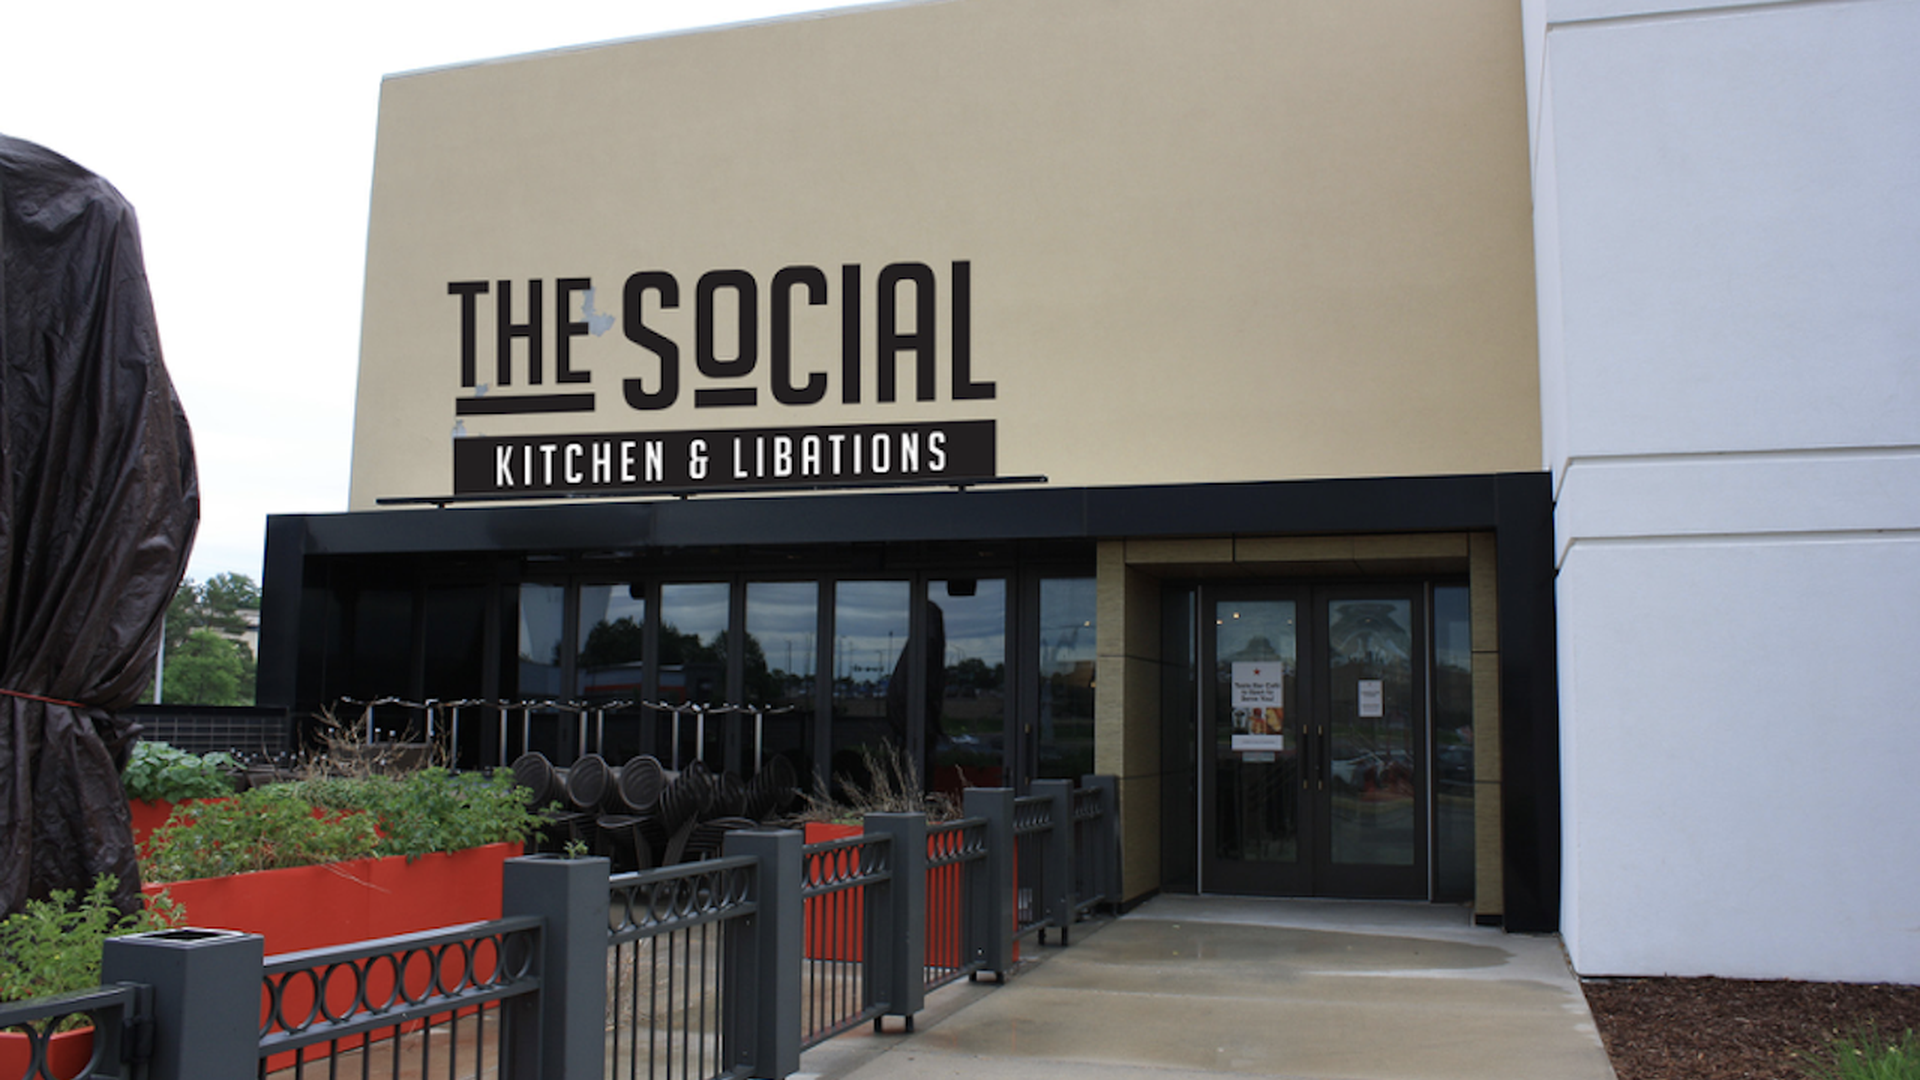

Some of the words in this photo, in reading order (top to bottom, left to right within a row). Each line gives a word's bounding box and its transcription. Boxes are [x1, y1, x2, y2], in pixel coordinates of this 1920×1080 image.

[447, 278, 592, 388] THE
[622, 260, 997, 411] SOCIAL
[496, 440, 664, 487] KITCHEN
[688, 438, 709, 480] &
[733, 431, 946, 479] LIBATIONS
